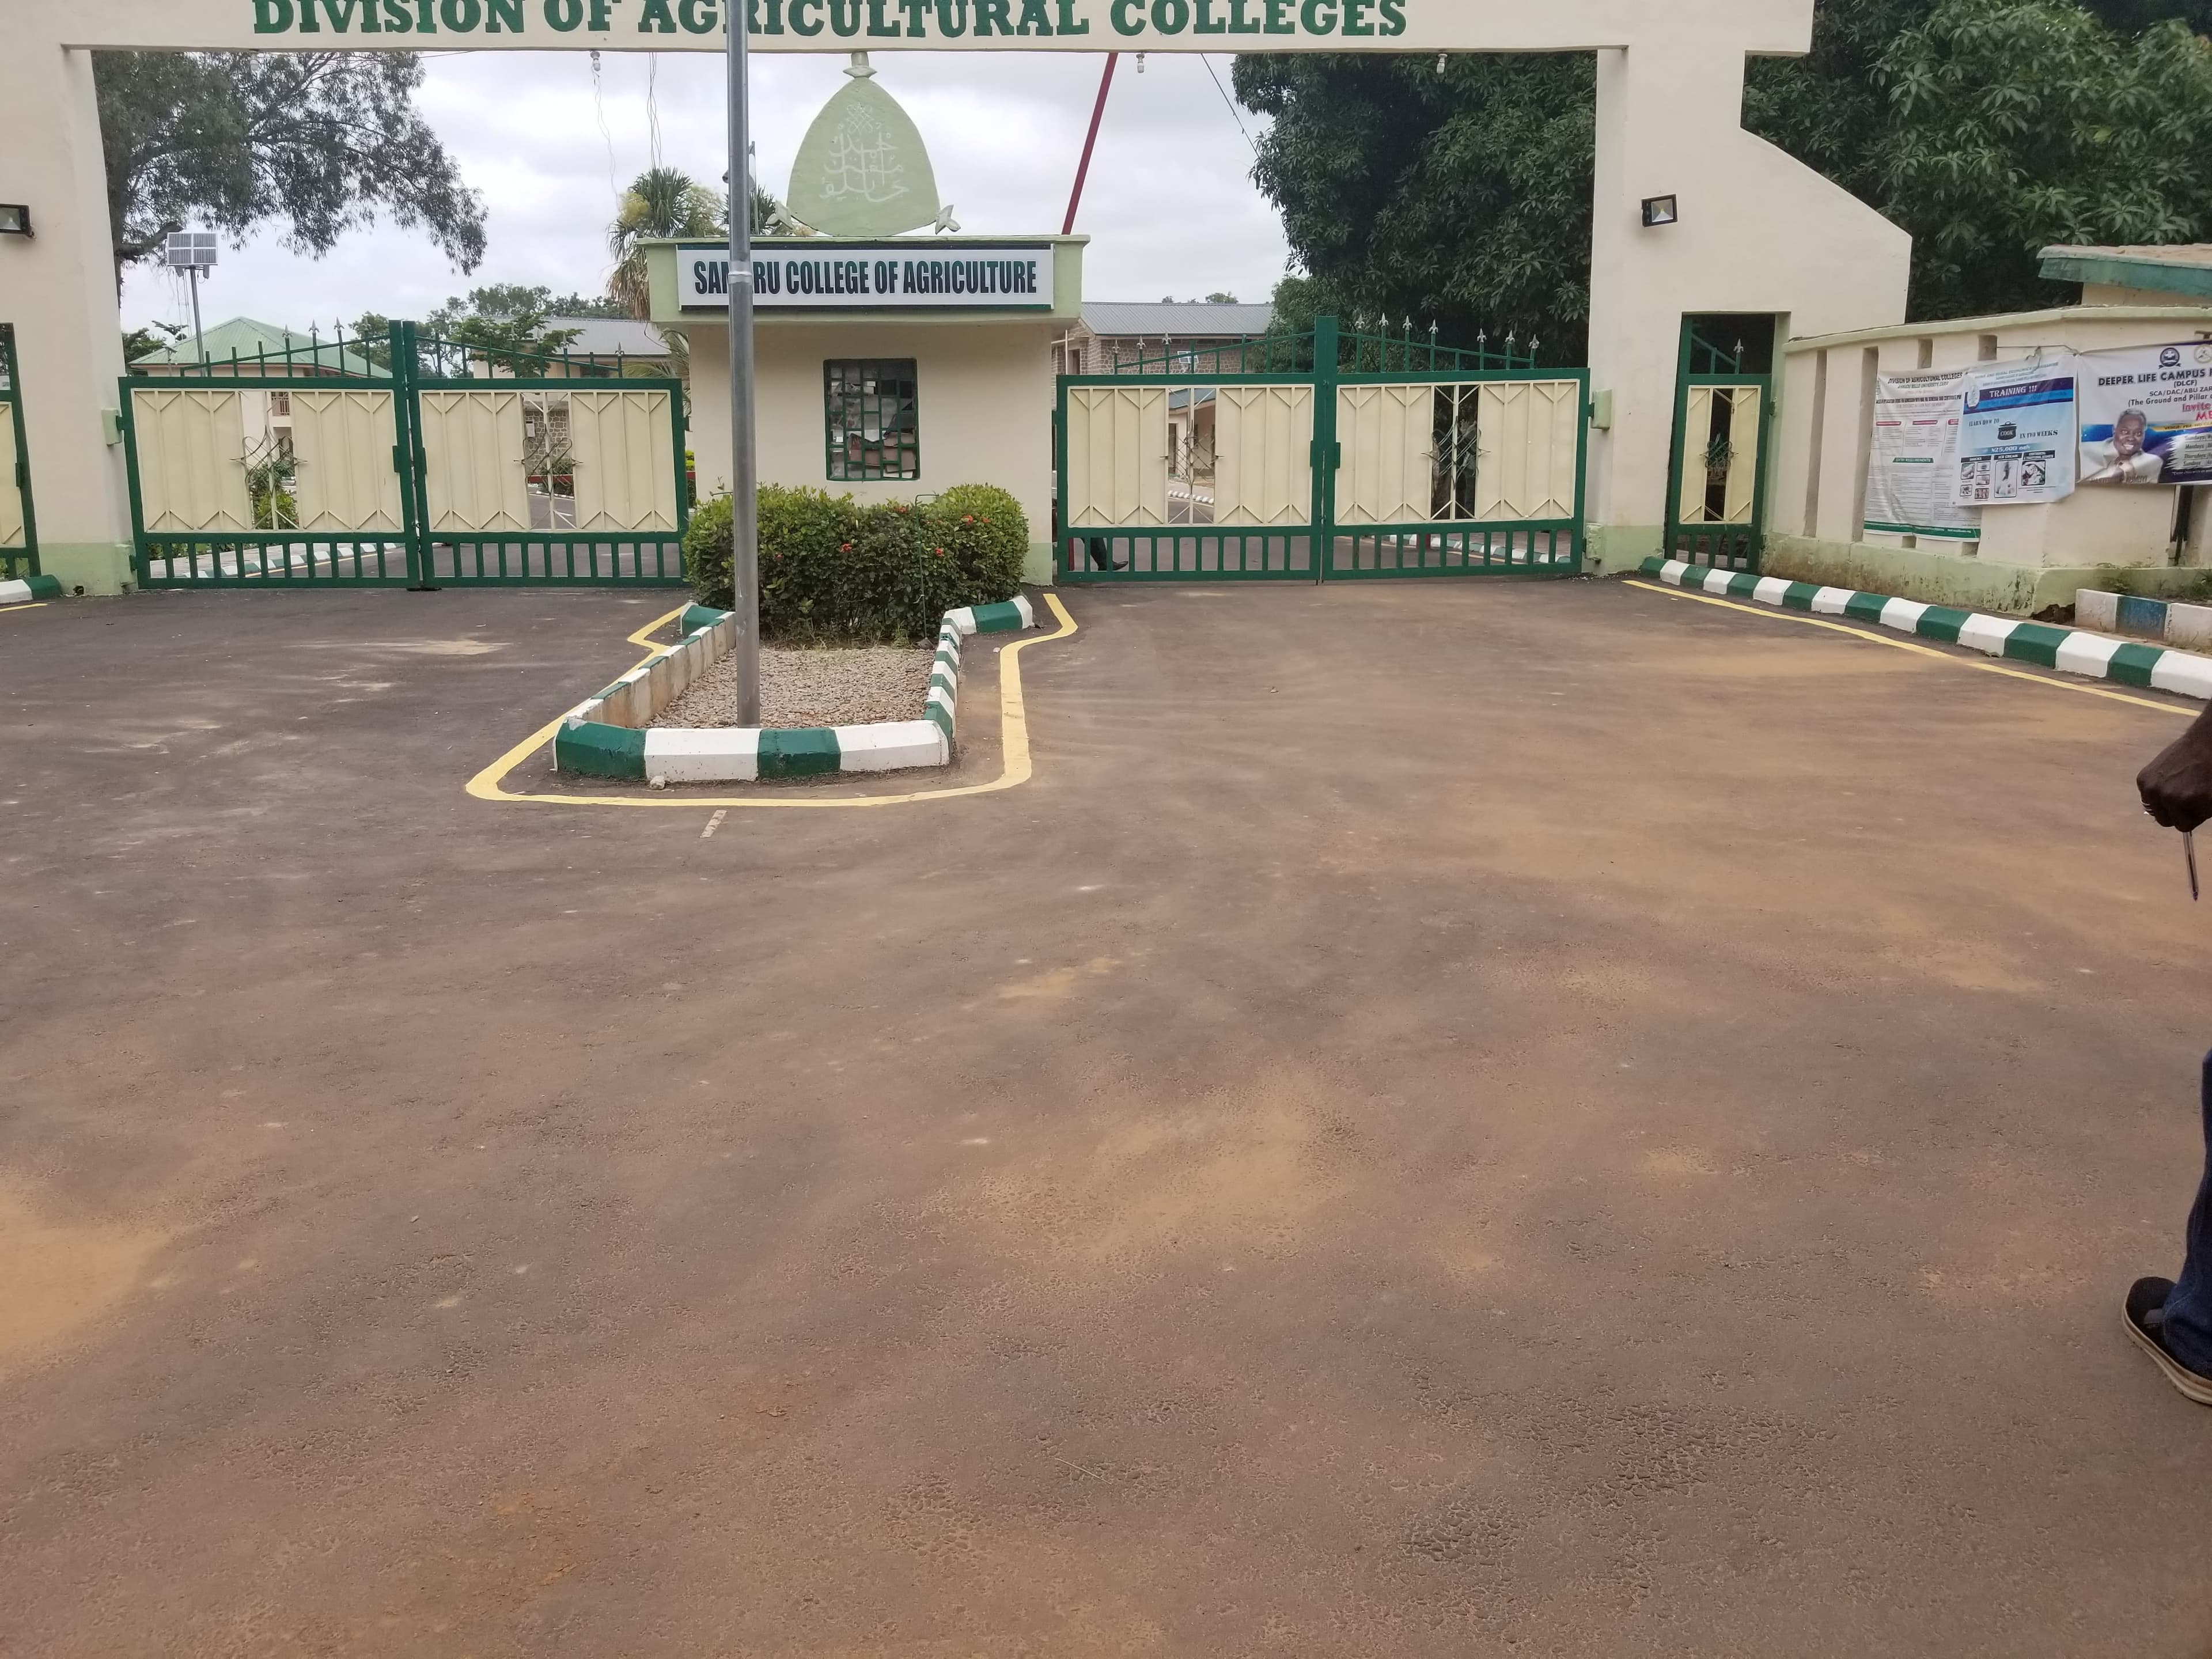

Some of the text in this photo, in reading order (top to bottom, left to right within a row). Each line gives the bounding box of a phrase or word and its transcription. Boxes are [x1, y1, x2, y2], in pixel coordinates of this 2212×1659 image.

[255, 0, 525, 33] DIVISION
[544, 0, 622, 32] OF
[1110, 0, 1407, 36] COLLEGES
[694, 260, 1037, 295] SARU COLLEGE OF AGRICULTURE
[1941, 372, 1963, 381] COLLEGES
[2099, 376, 2134, 386] DEEPER
[2138, 374, 2156, 383] LIFE
[2160, 369, 2205, 381] CAMPUS
[2173, 379, 2198, 388] (DLCF)
[1989, 386, 2027, 397] TRAINING
[2149, 387, 2198, 397] SCA/DAC/ABU
[2128, 399, 2143, 407] (The
[2146, 395, 2171, 404] Ground
[2173, 394, 2186, 402] and
